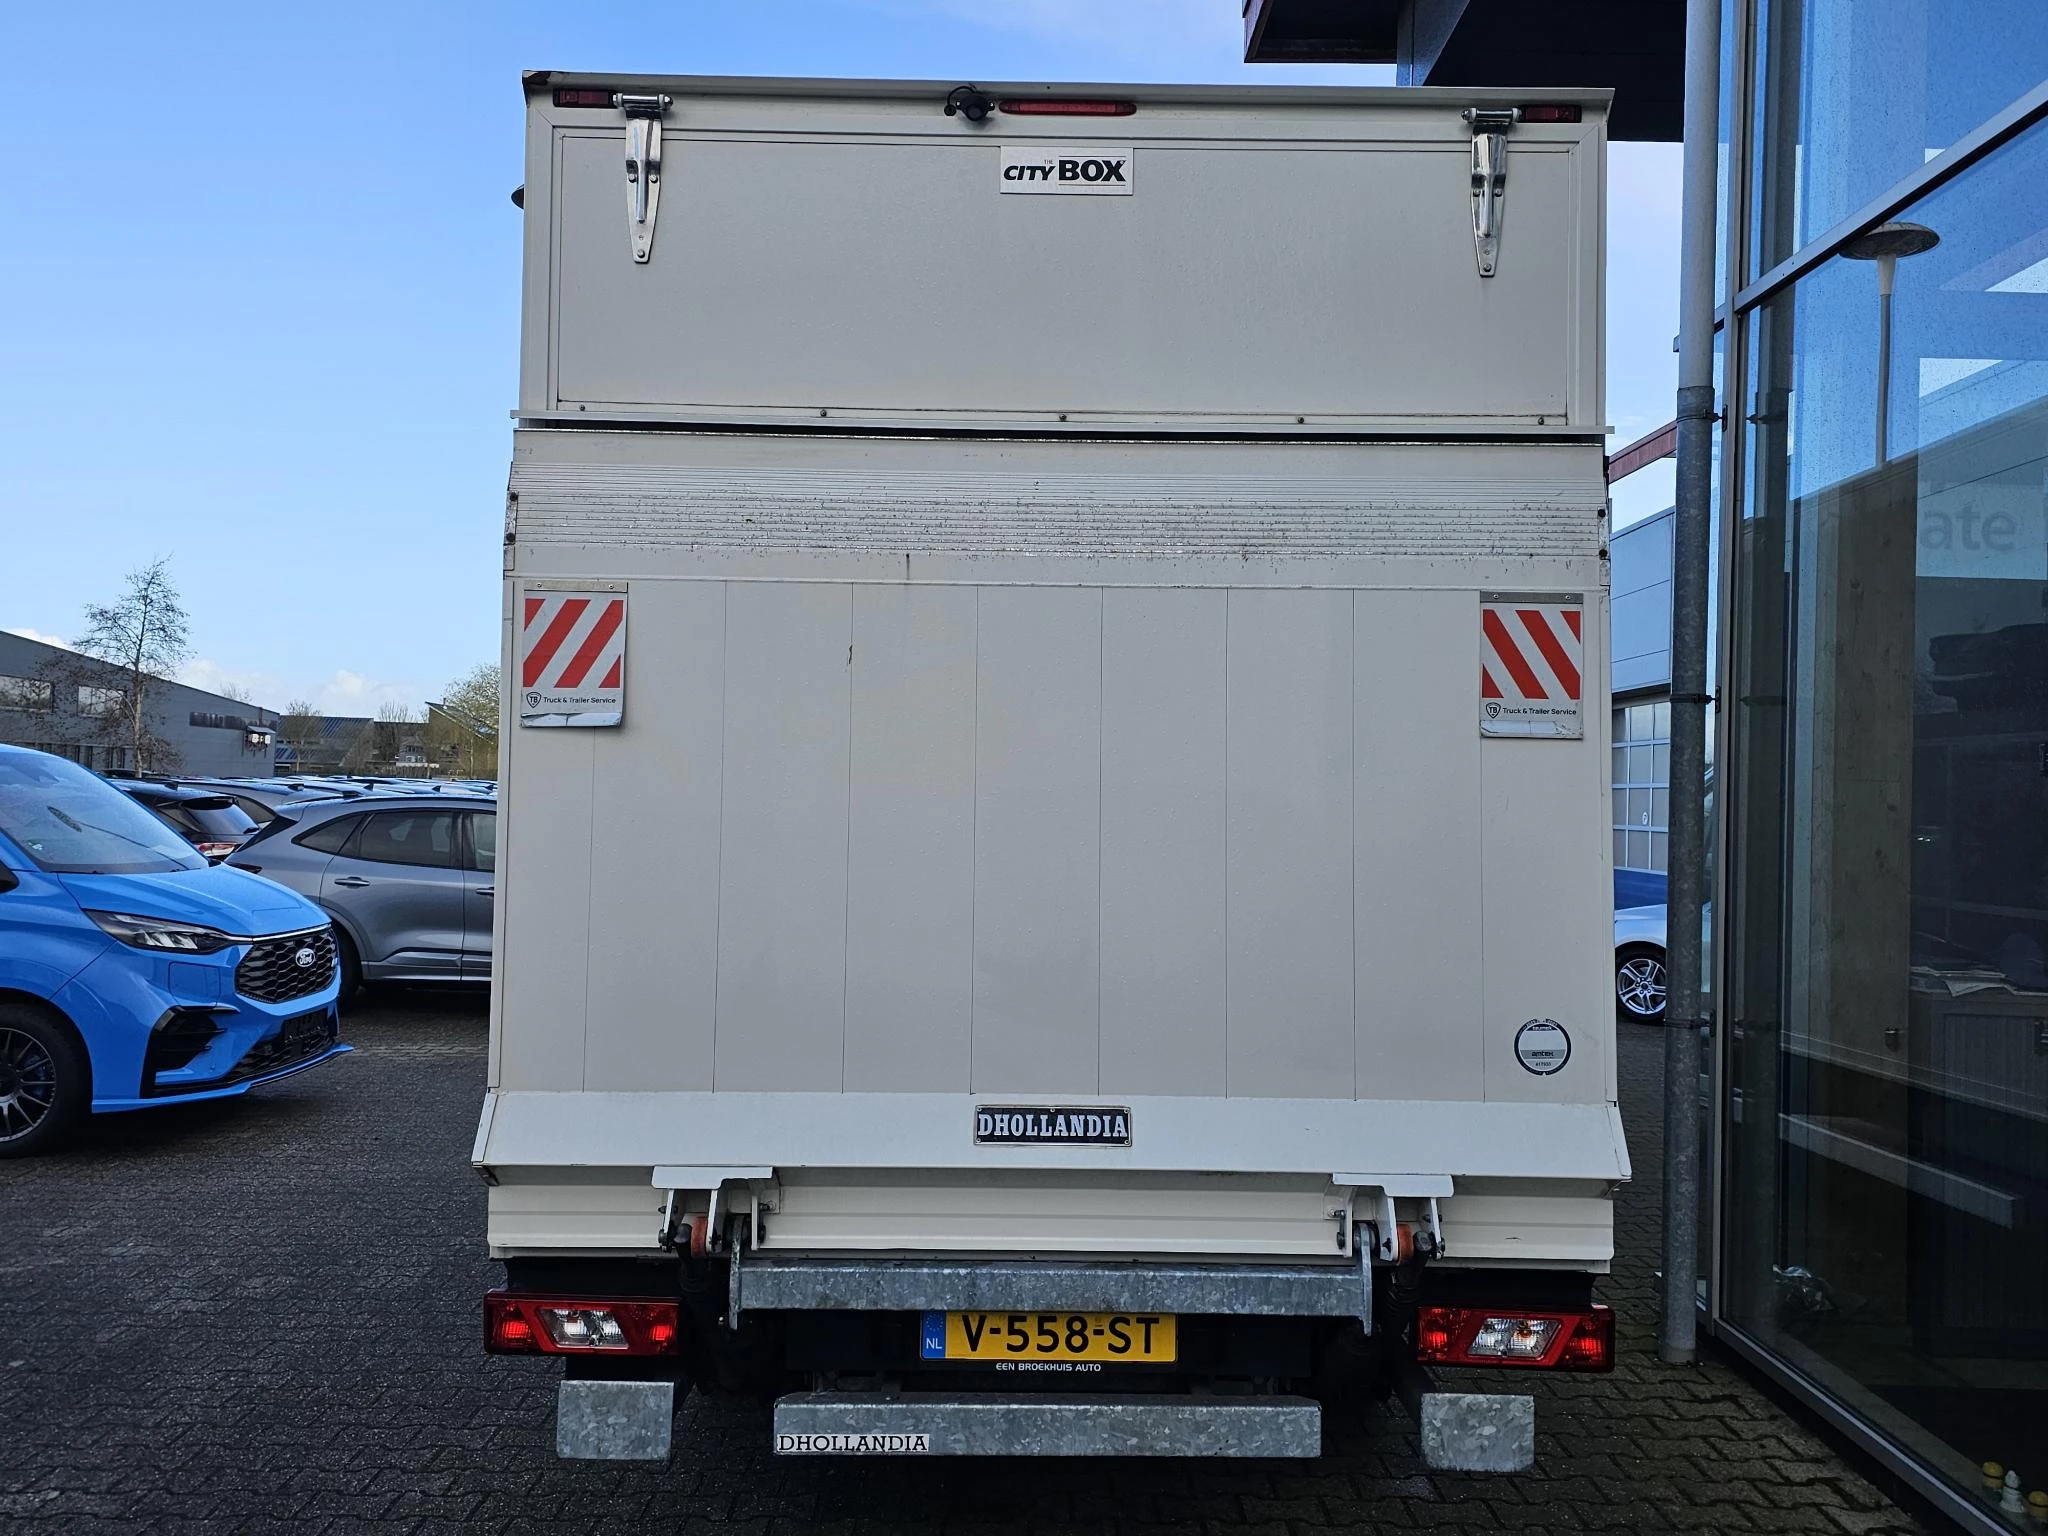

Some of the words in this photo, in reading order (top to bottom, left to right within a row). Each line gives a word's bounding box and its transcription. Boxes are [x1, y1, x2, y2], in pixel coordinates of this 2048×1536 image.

[1003, 165, 1056, 181] CITY
[1058, 159, 1126, 182] BOX
[529, 696, 539, 704] TB
[543, 696, 562, 704] Truck
[1488, 706, 1498, 714] TB
[1529, 707, 1550, 715] Trailer
[977, 1113, 1128, 1137] DHOLLANDIA
[926, 1338, 943, 1350] NL
[961, 1314, 1160, 1354] V-558-ST
[995, 1362, 1015, 1371] EEN
[1018, 1362, 1073, 1372] BROEKHUIS
[1075, 1363, 1102, 1372] AUTO
[779, 1435, 928, 1451] DHOLLANDIA
